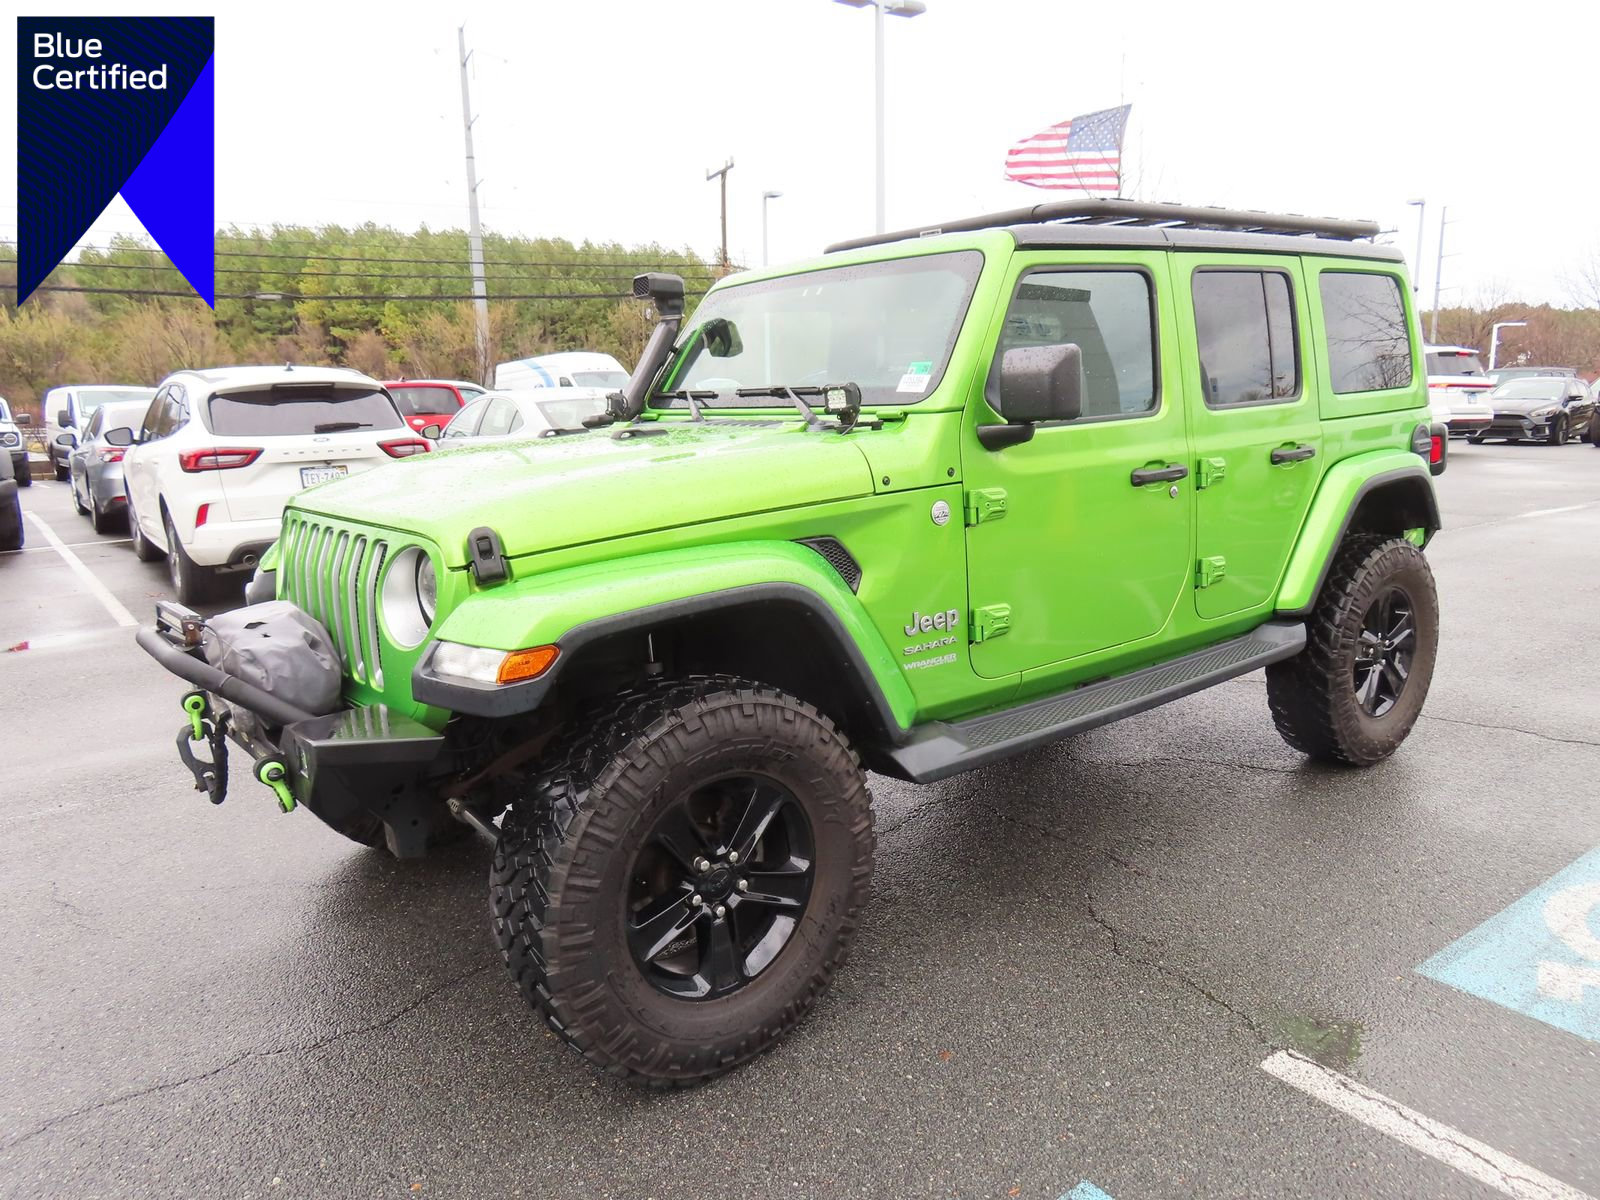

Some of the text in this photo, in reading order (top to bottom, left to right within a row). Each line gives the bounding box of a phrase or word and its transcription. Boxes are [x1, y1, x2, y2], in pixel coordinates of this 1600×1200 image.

[904, 609, 959, 637] Jeep
[903, 635, 957, 656] SAHARA
[903, 653, 957, 670] WRANGLER
